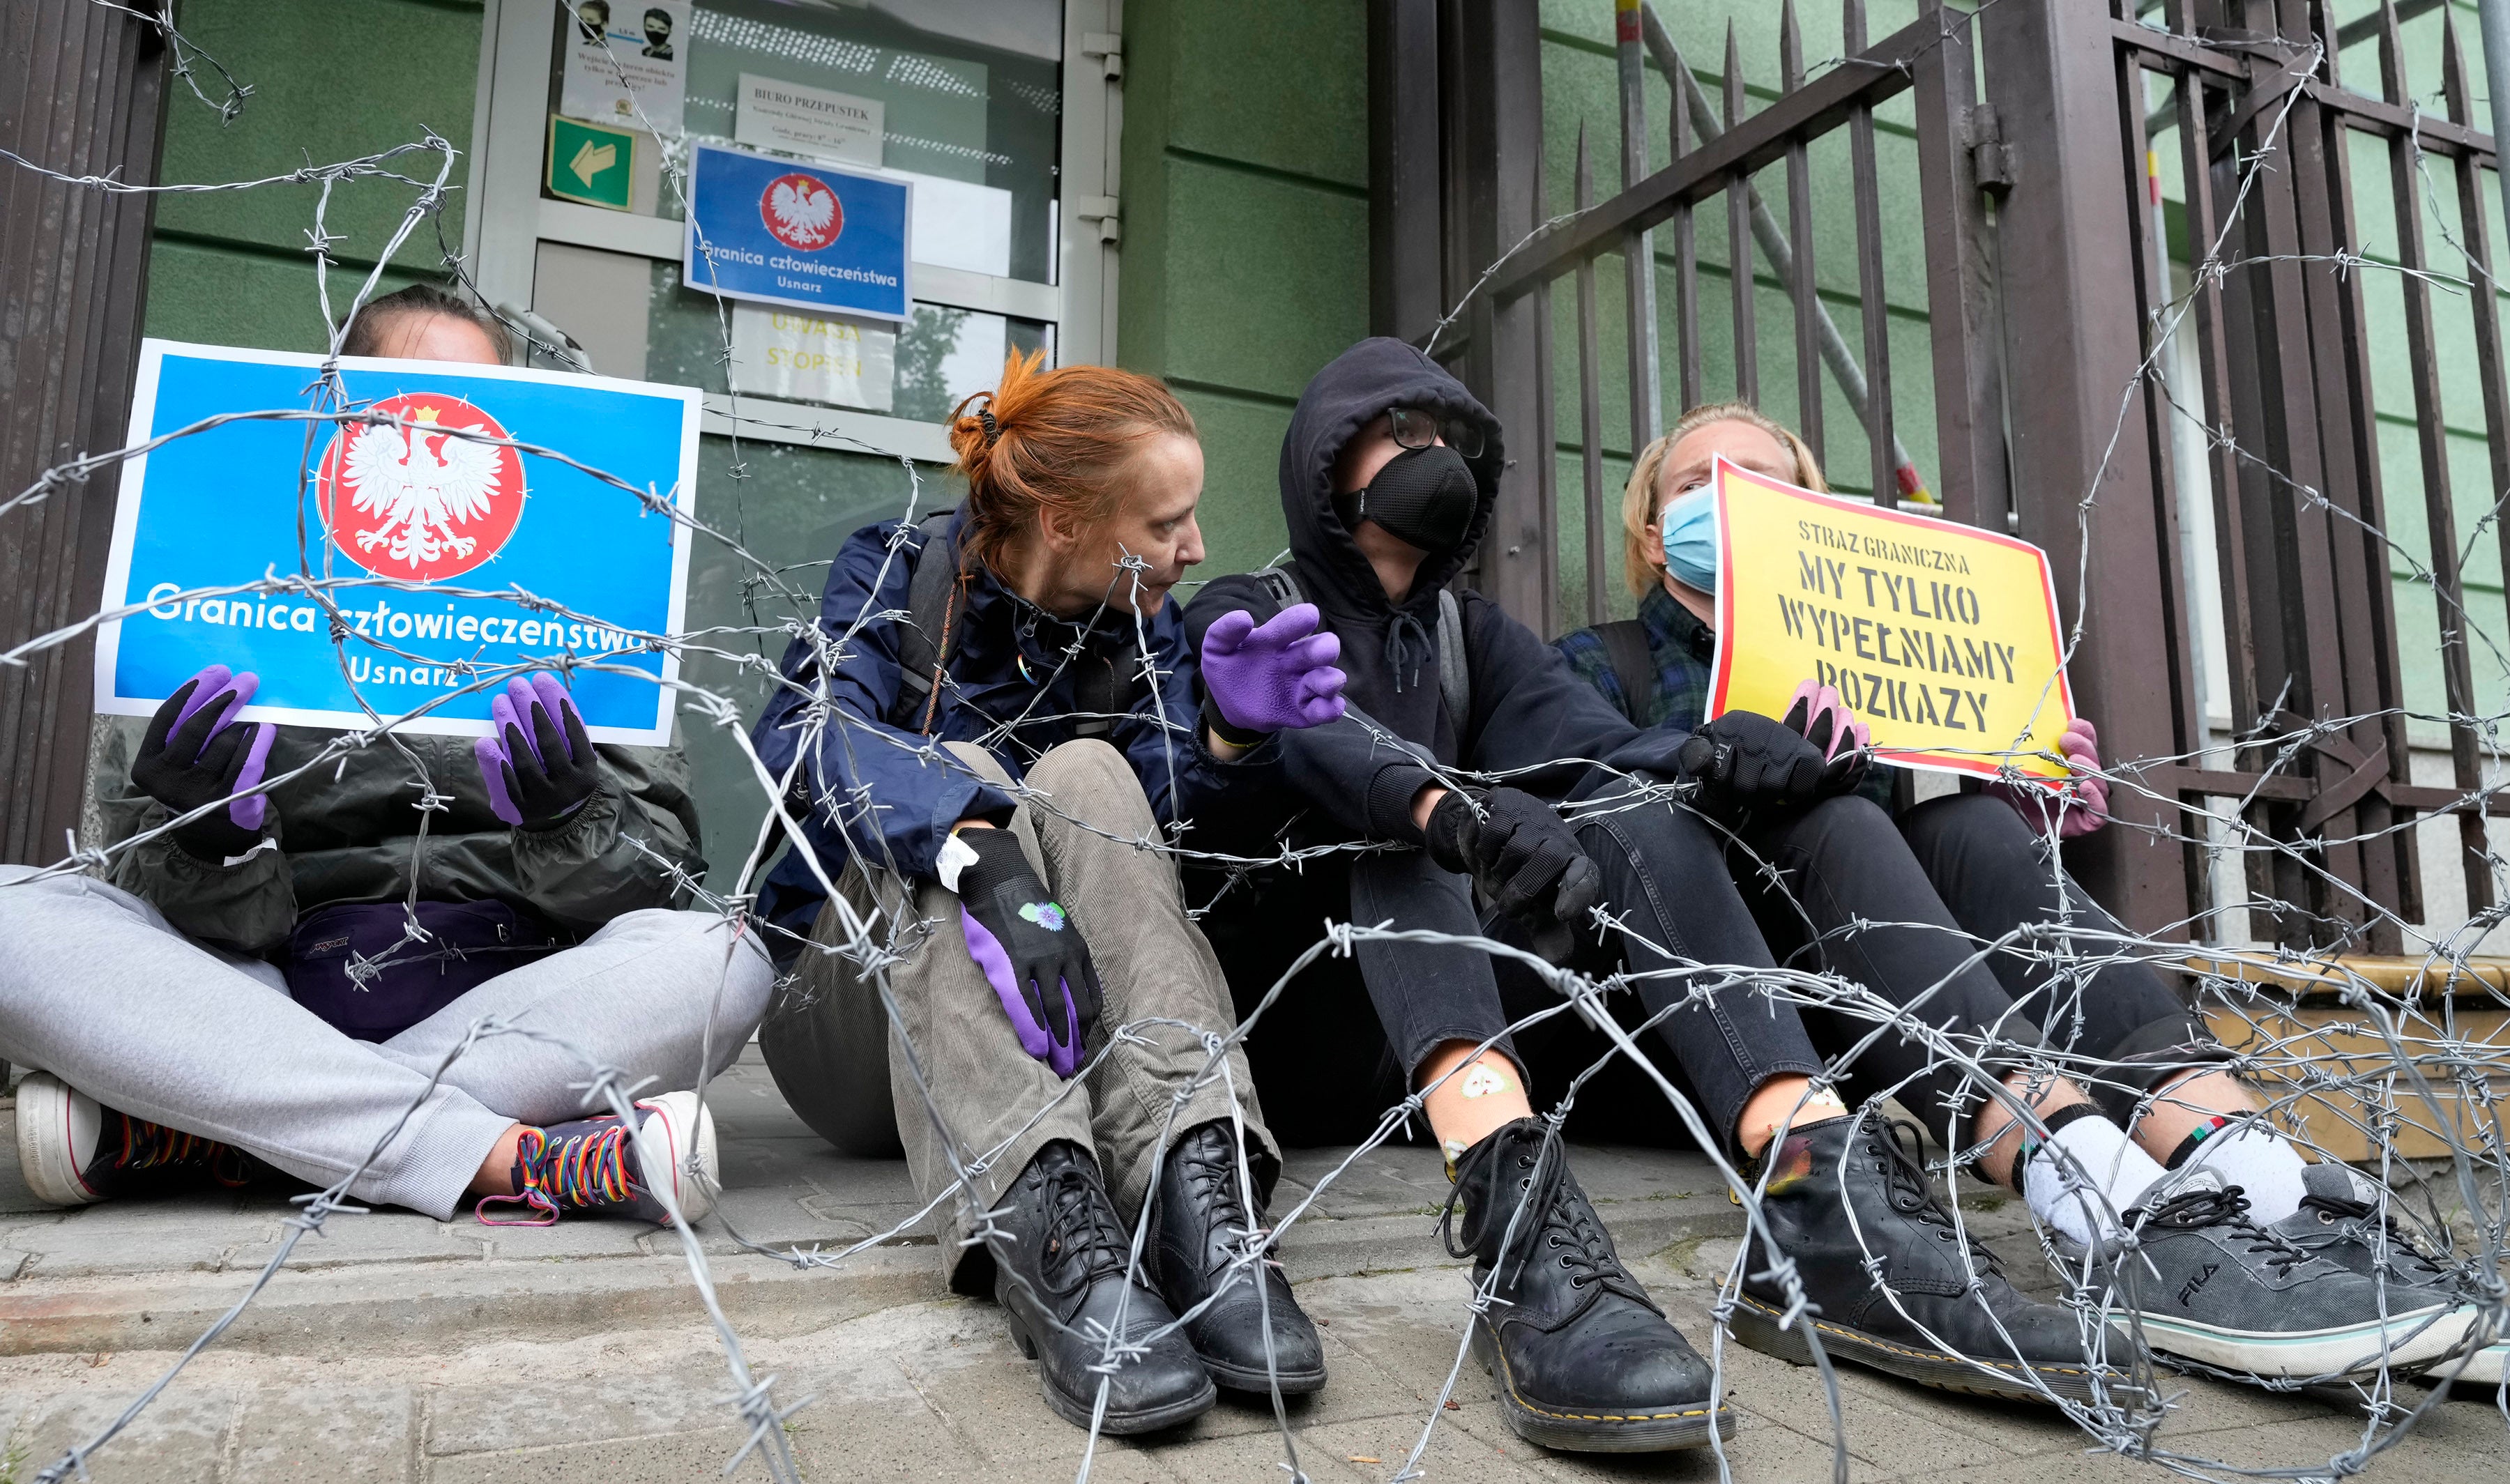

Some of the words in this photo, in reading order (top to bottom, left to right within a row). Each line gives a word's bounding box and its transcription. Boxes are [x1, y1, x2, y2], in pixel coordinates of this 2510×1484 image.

[754, 88, 792, 105] BIURO
[795, 97, 869, 121] PRZEPUSTEK
[699, 240, 764, 266] Granica
[769, 255, 897, 287] człowieczeństwa
[777, 276, 822, 293] Usnarz
[772, 312, 861, 342] UWAGA
[1864, 537, 1970, 576] GRANICZNA
[146, 583, 315, 632] Granica
[1798, 550, 1846, 600] MY
[1857, 566, 1980, 625] TYLKO
[1777, 594, 2014, 684] WYPEŁNIAMY
[349, 656, 459, 687] Usnarz
[2177, 1262, 2221, 1308] FILA
